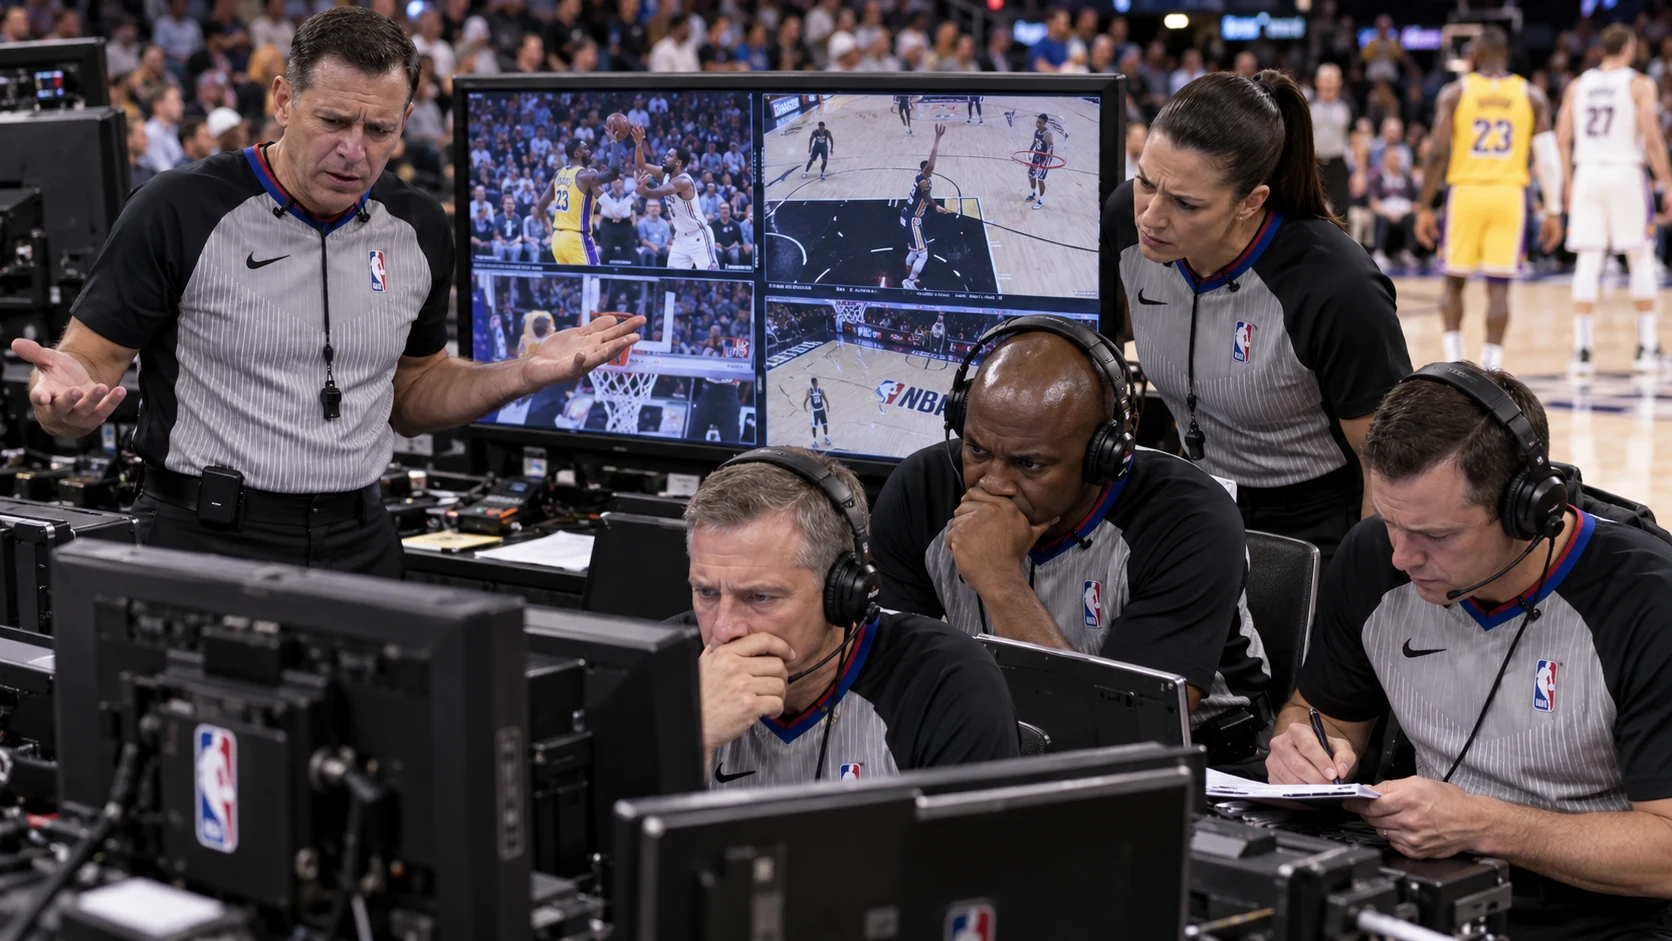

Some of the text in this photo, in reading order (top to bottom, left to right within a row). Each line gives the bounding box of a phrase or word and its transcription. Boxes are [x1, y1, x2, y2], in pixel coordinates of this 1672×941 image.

[1472, 118, 1514, 155] 23
[1585, 106, 1616, 137] 27
[555, 189, 569, 211] 23
